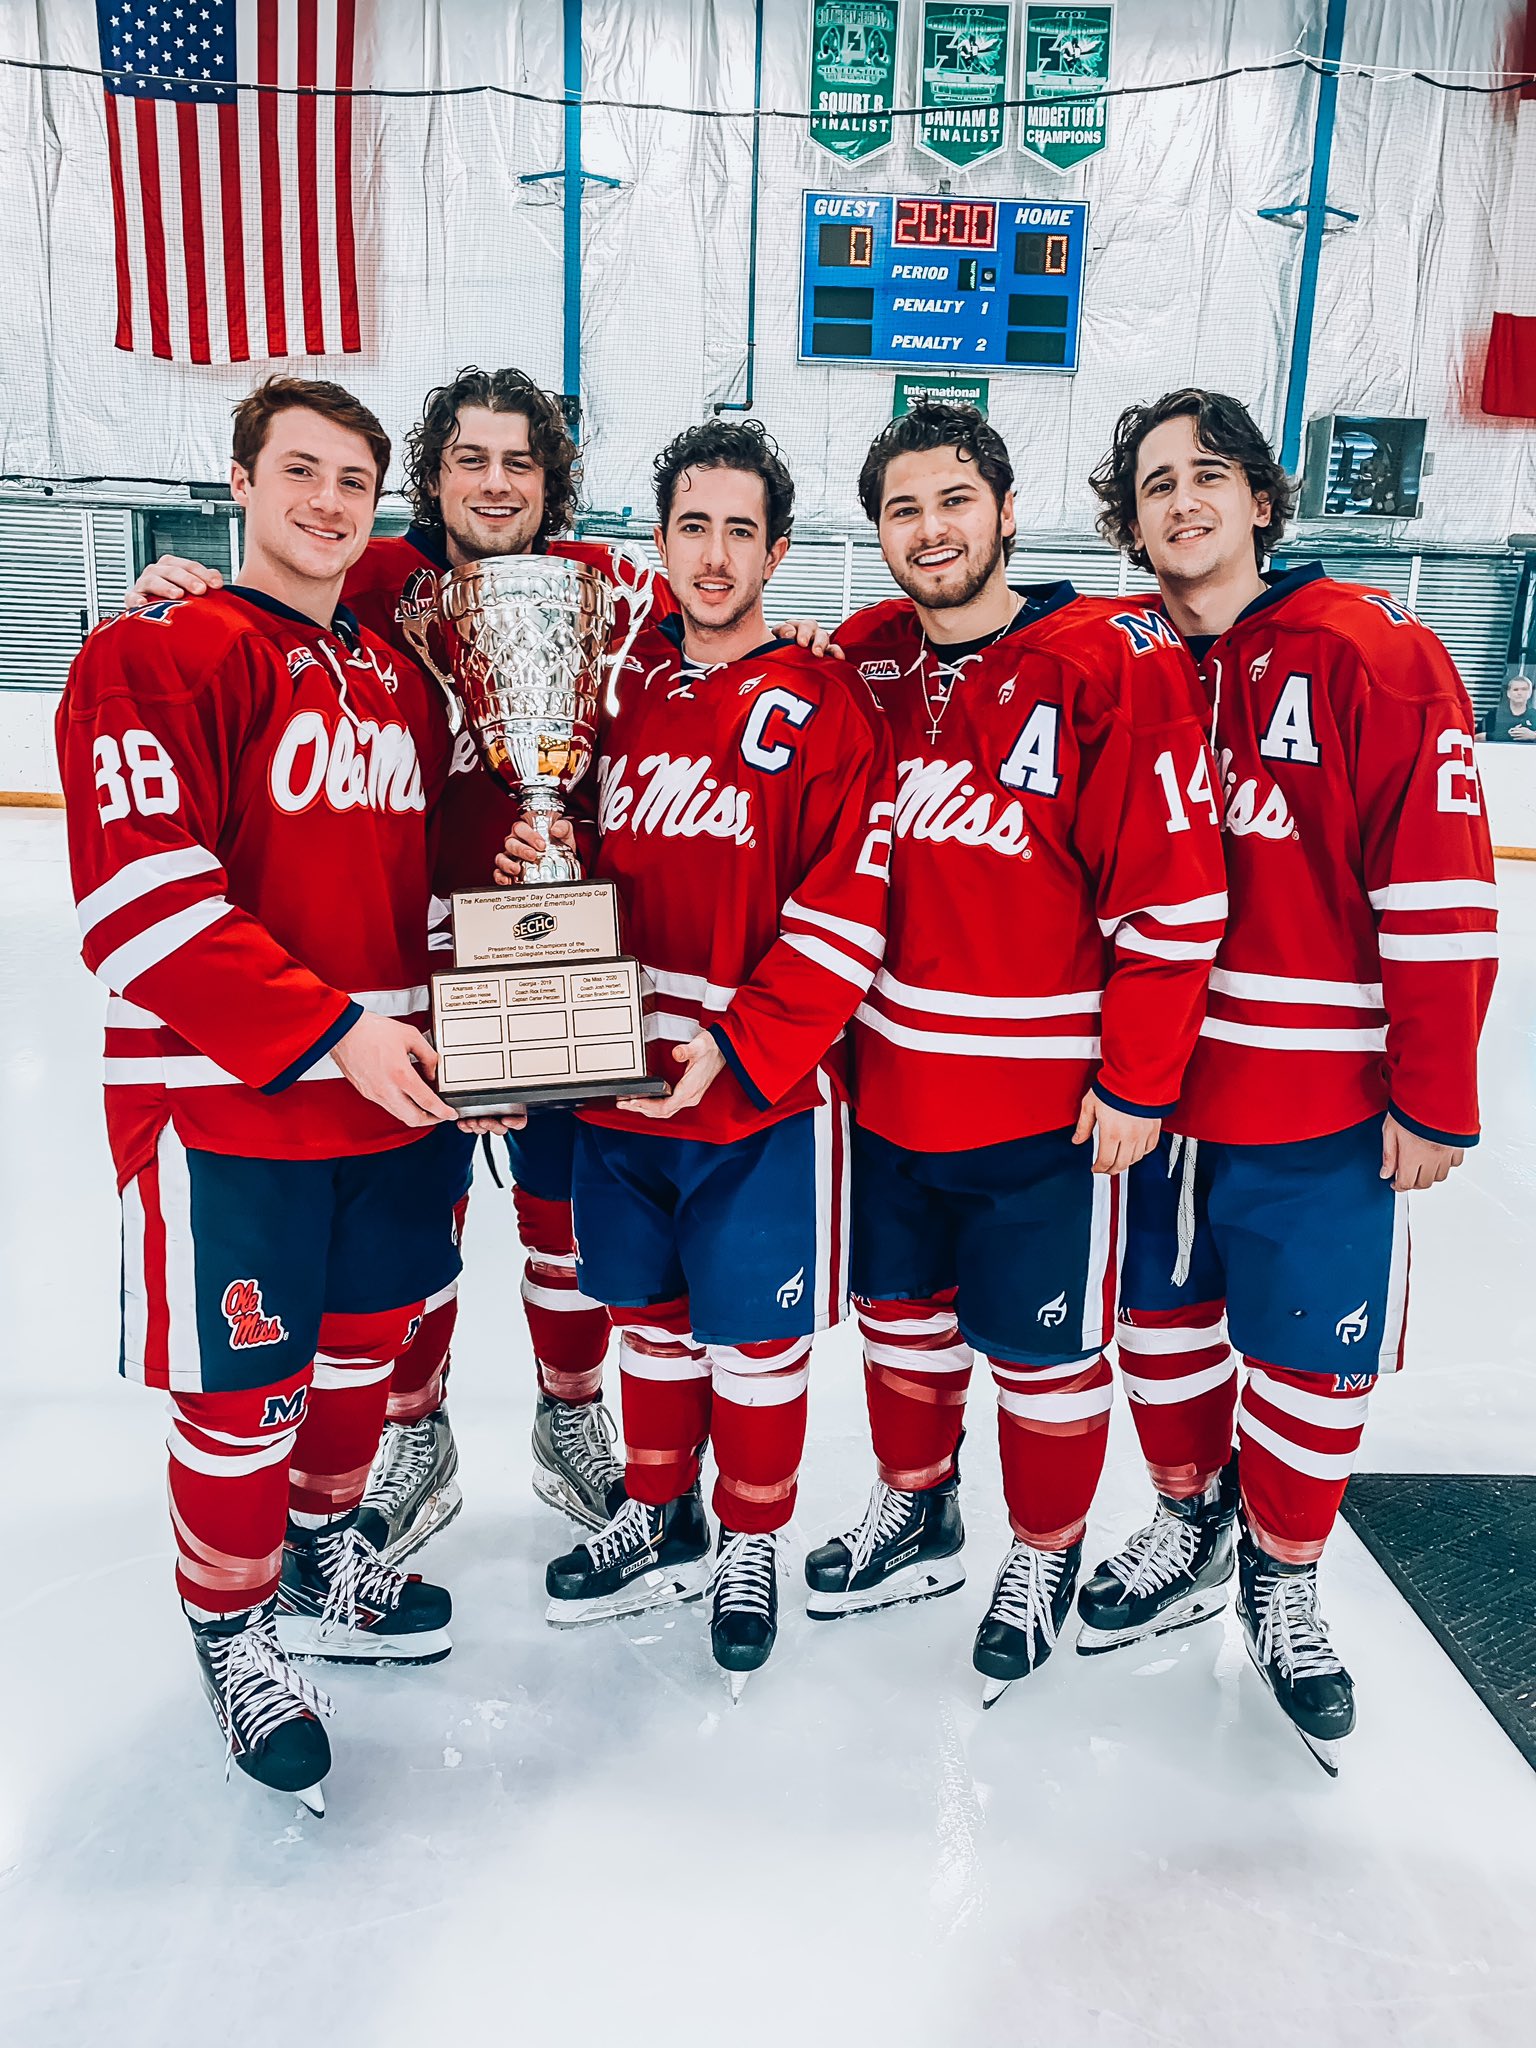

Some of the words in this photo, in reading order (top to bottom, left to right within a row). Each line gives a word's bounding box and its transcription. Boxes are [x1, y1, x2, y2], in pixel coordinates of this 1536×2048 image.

[819, 91, 871, 116] SQUIRT
[874, 94, 884, 113] B
[812, 118, 889, 132] FINALIST
[989, 108, 999, 127] B
[1028, 106, 1070, 127] MIDGET
[1073, 107, 1094, 128] U18
[923, 128, 1000, 143] FINALIST
[1026, 129, 1102, 144] CHAMPIONS
[814, 199, 880, 218] GUEST
[1015, 208, 1074, 226] HOME
[897, 202, 993, 245] 20:00
[850, 226, 872, 266] 0
[1045, 235, 1068, 274] 0
[891, 265, 949, 280] PERIOD
[892, 298, 965, 314] PENALTY
[981, 301, 989, 315] 1
[891, 335, 963, 350] PENALTY
[975, 338, 988, 351] 2
[903, 385, 980, 398] International
[1107, 610, 1184, 657] M
[859, 660, 898, 676] ACHA
[740, 686, 817, 775] C
[1259, 672, 1323, 768] A
[1000, 699, 1064, 799] A
[271, 711, 368, 813] Ole
[597, 754, 634, 837] le
[632, 753, 754, 847] Miss
[1153, 744, 1219, 834] 14
[896, 757, 1030, 857] Miss
[474, 896, 502, 904] Kenneth
[530, 894, 543, 902] Day
[546, 890, 592, 900] Championship
[594, 890, 608, 898] Cup
[492, 901, 542, 911] (Commissioner
[544, 899, 576, 908] Emeritus)
[487, 945, 517, 953] Presented
[536, 942, 567, 951] Champions
[492, 952, 514, 960] Eastern
[515, 950, 544, 959] Collegiate
[545, 949, 566, 958] Hockey
[567, 947, 600, 955] Conference
[225, 1282, 259, 1316] Ole
[232, 1312, 281, 1347] Miss
[260, 1385, 307, 1428] M
